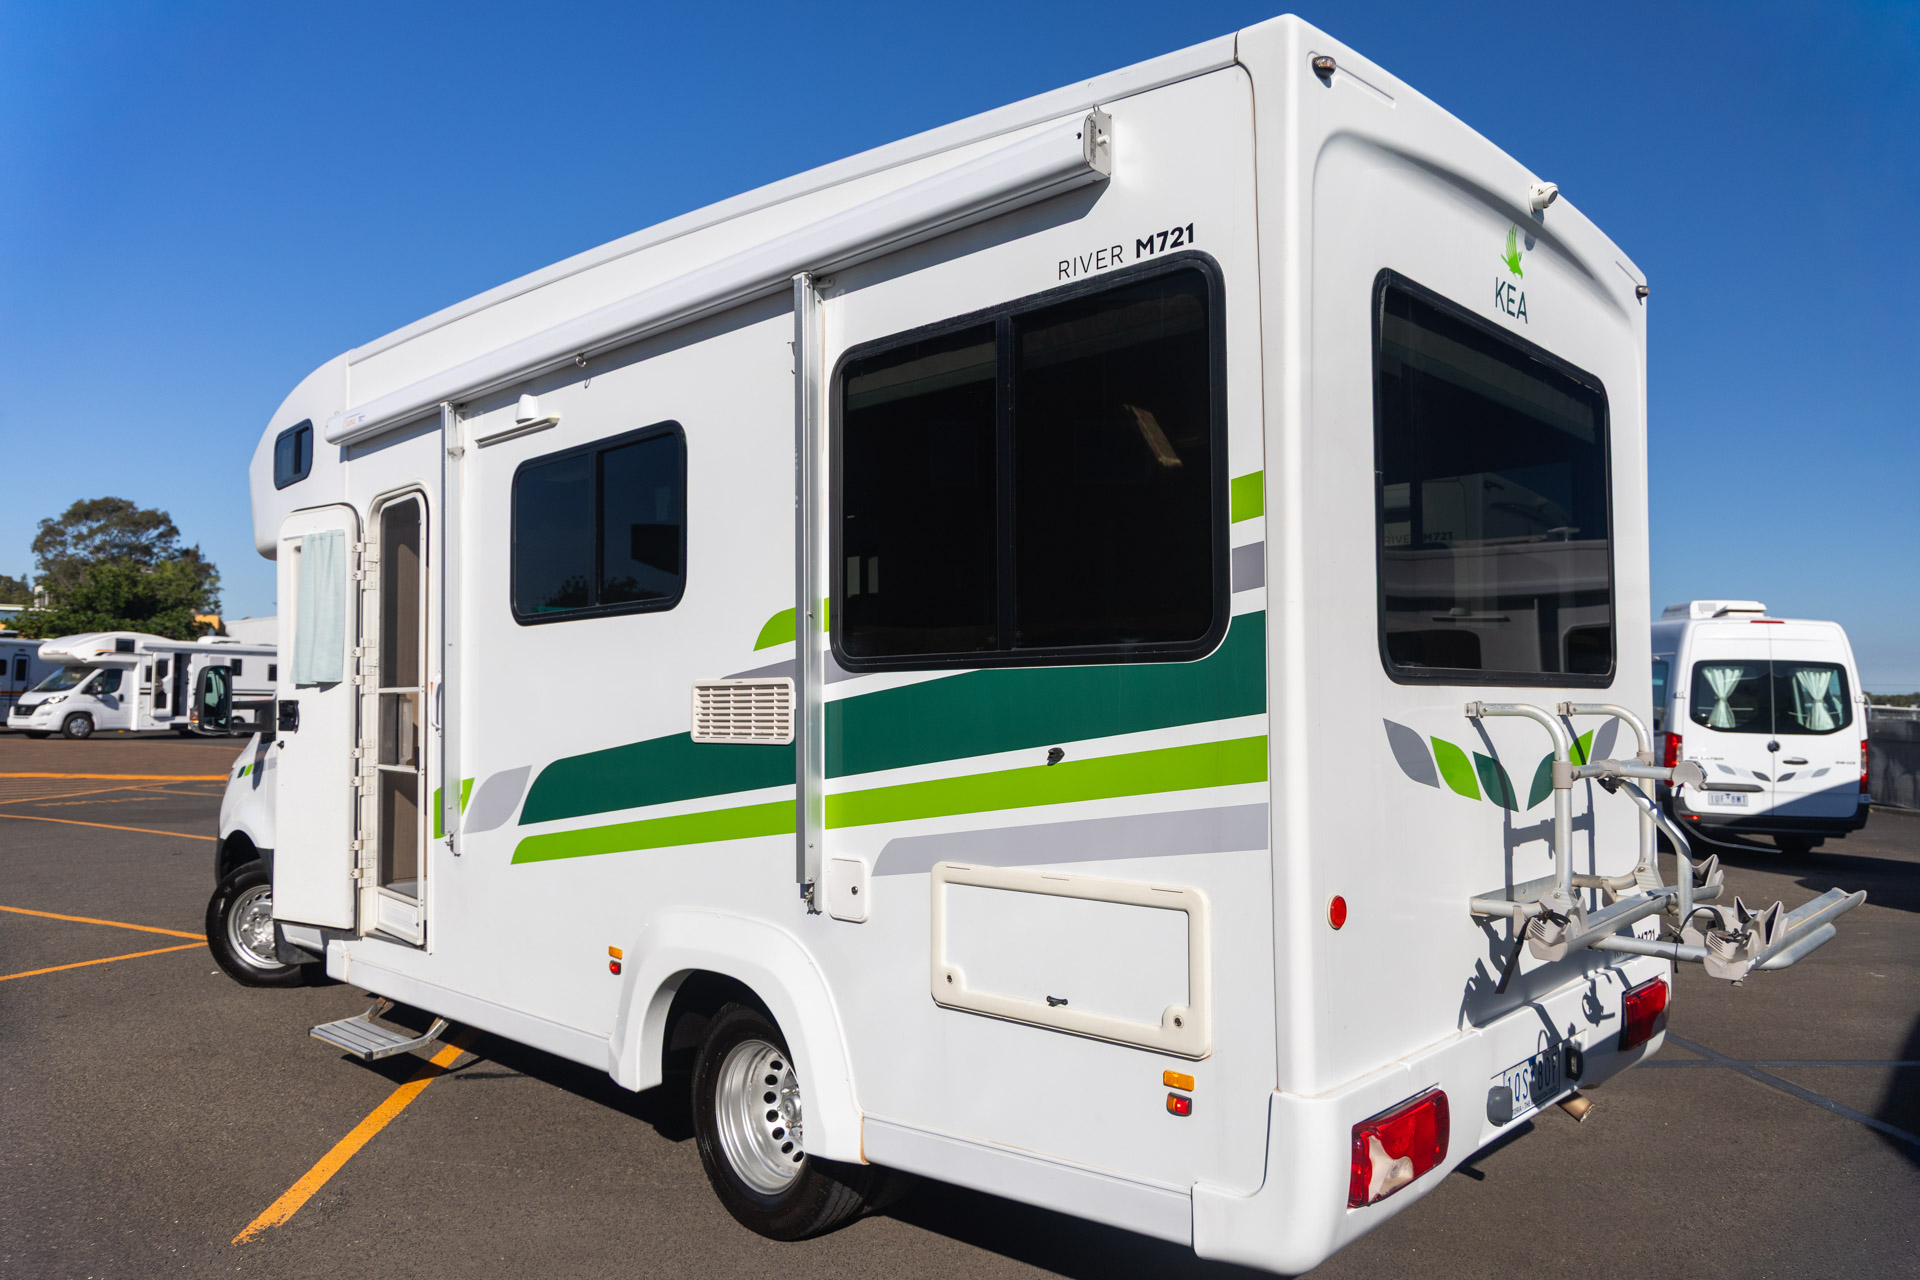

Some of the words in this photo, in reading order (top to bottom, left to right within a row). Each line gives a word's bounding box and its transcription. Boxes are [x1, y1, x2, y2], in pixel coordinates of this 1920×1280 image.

[1058, 244, 1124, 281] RIVER
[1135, 222, 1194, 259] M721
[1495, 276, 1528, 324] KEA
[1384, 534, 1411, 545] RIVE
